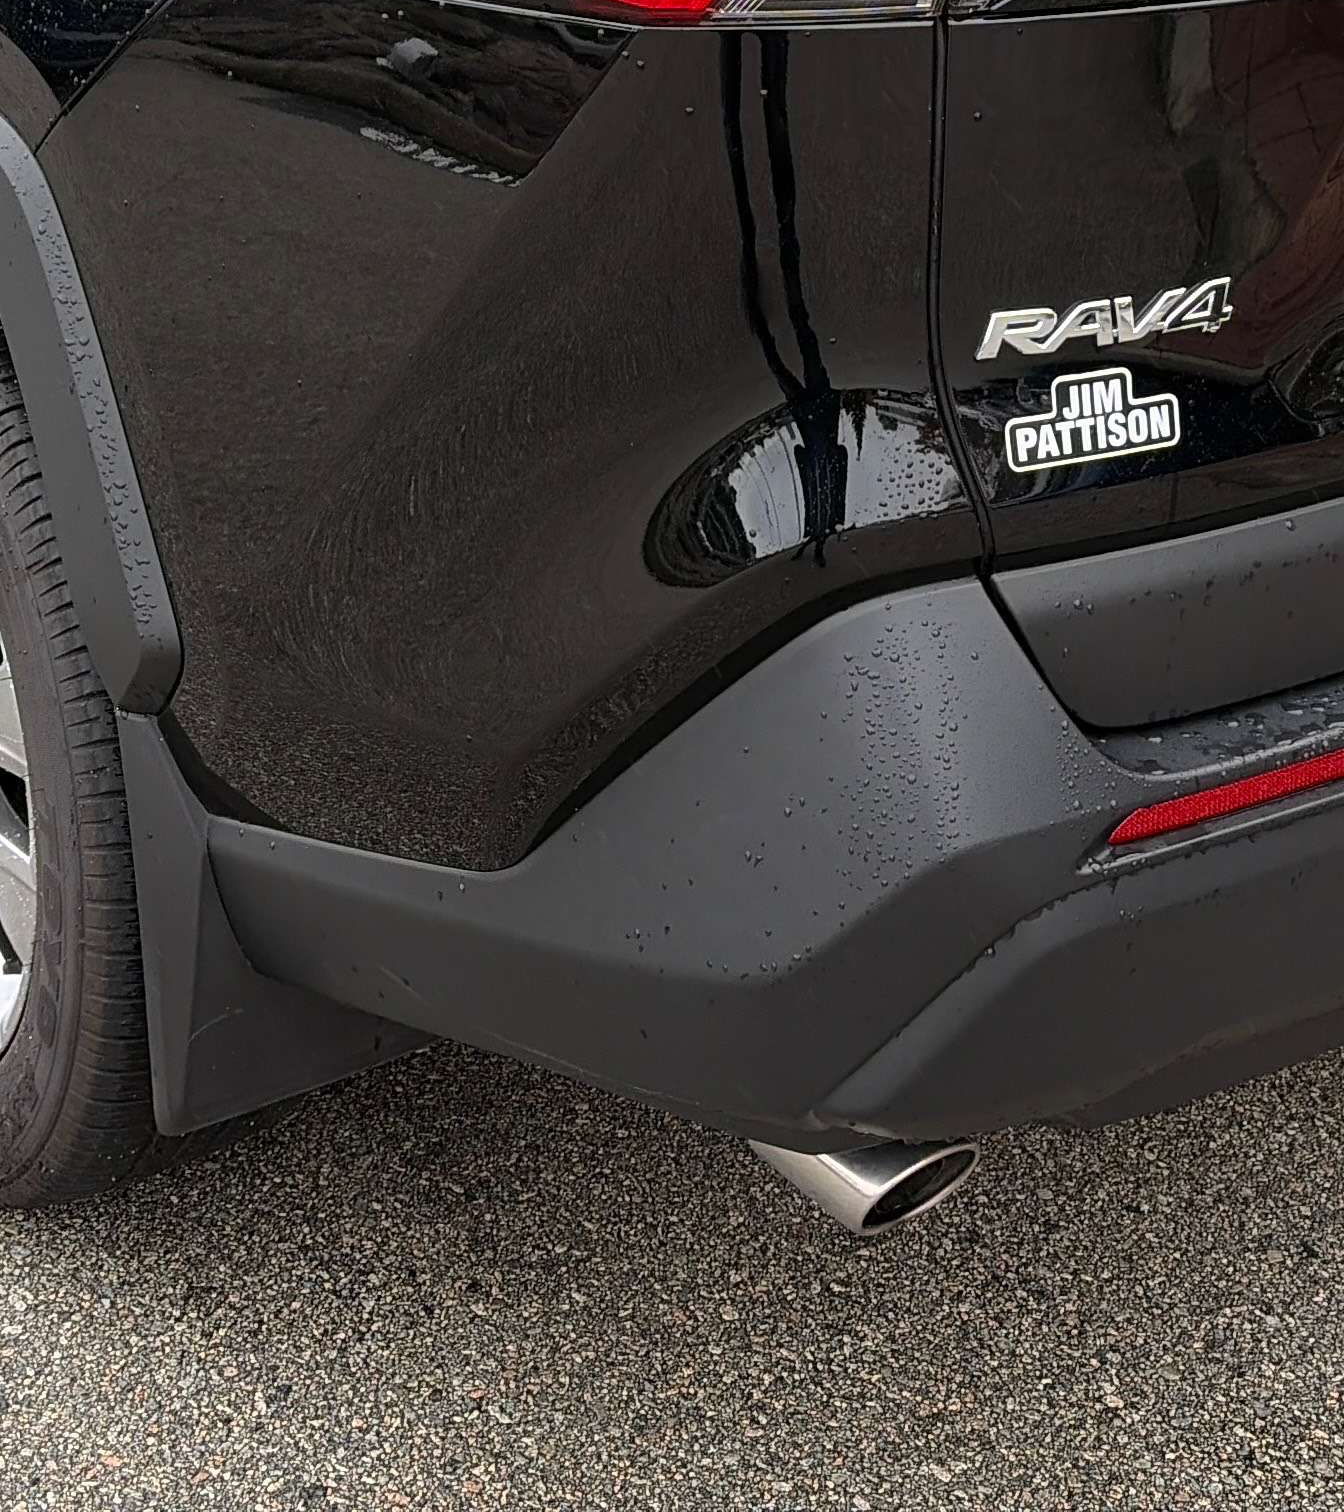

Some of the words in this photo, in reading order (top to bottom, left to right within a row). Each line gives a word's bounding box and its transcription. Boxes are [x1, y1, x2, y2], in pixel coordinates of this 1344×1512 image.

[974, 276, 1234, 361] RAV4
[1062, 377, 1123, 420] JIM
[1015, 404, 1172, 463] PATTISON
